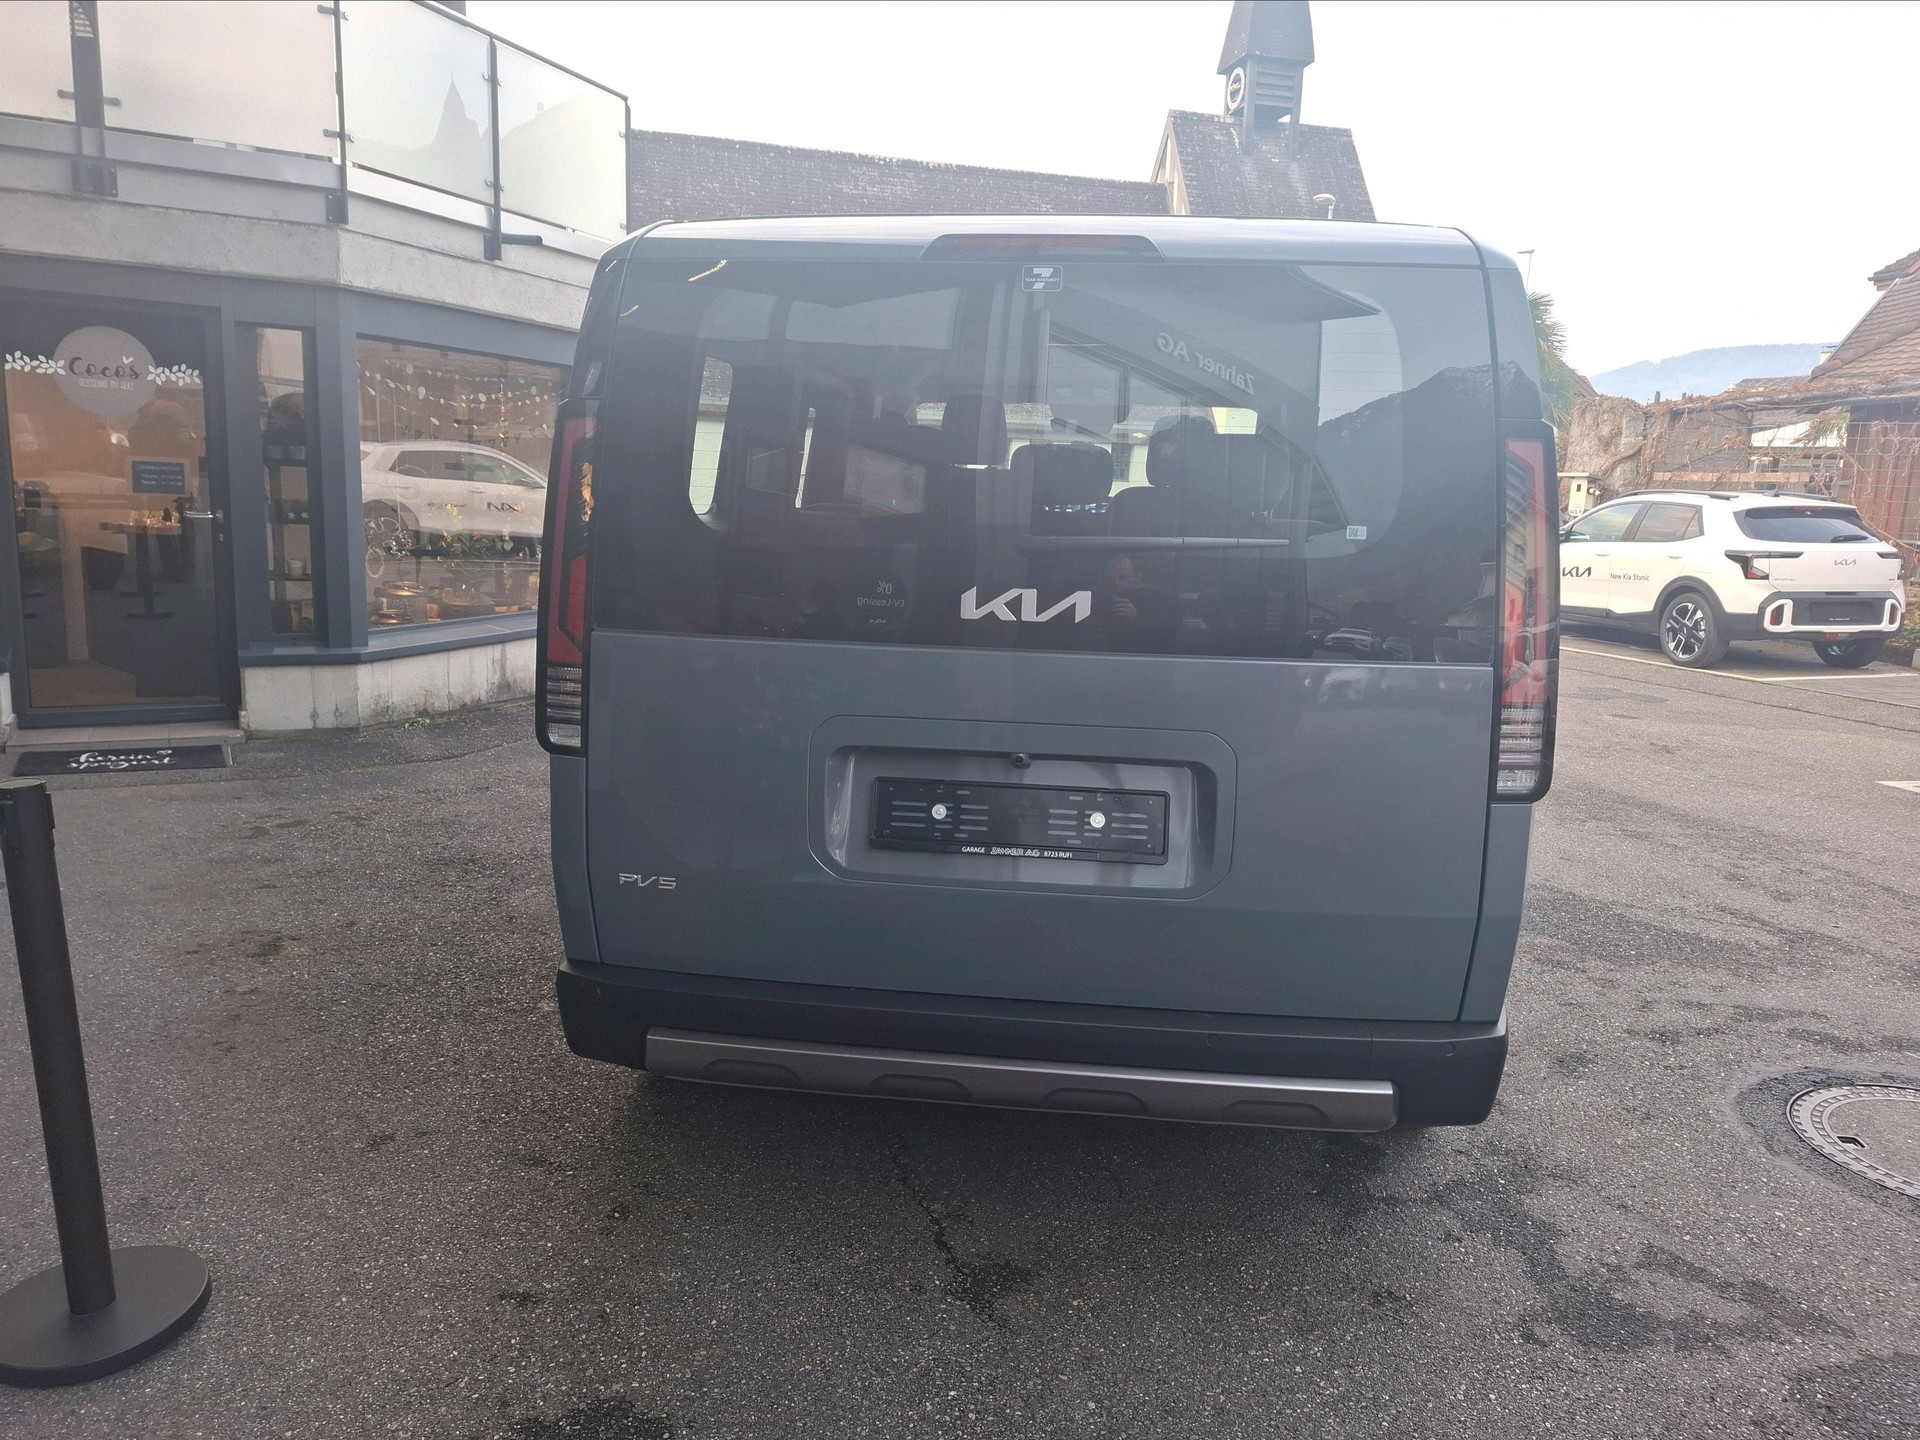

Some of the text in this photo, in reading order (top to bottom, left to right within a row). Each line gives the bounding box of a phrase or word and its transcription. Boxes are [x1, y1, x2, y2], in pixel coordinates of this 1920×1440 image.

[1834, 558, 1857, 566] KIA
[1562, 566, 1592, 578] KIA
[1622, 573, 1632, 581] Kia
[1632, 573, 1650, 582] Stonic
[960, 586, 1092, 624] KIA
[961, 846, 1073, 859] GARAGE ZAHNER AG 8723 RUFI
[619, 873, 676, 890] PV5
